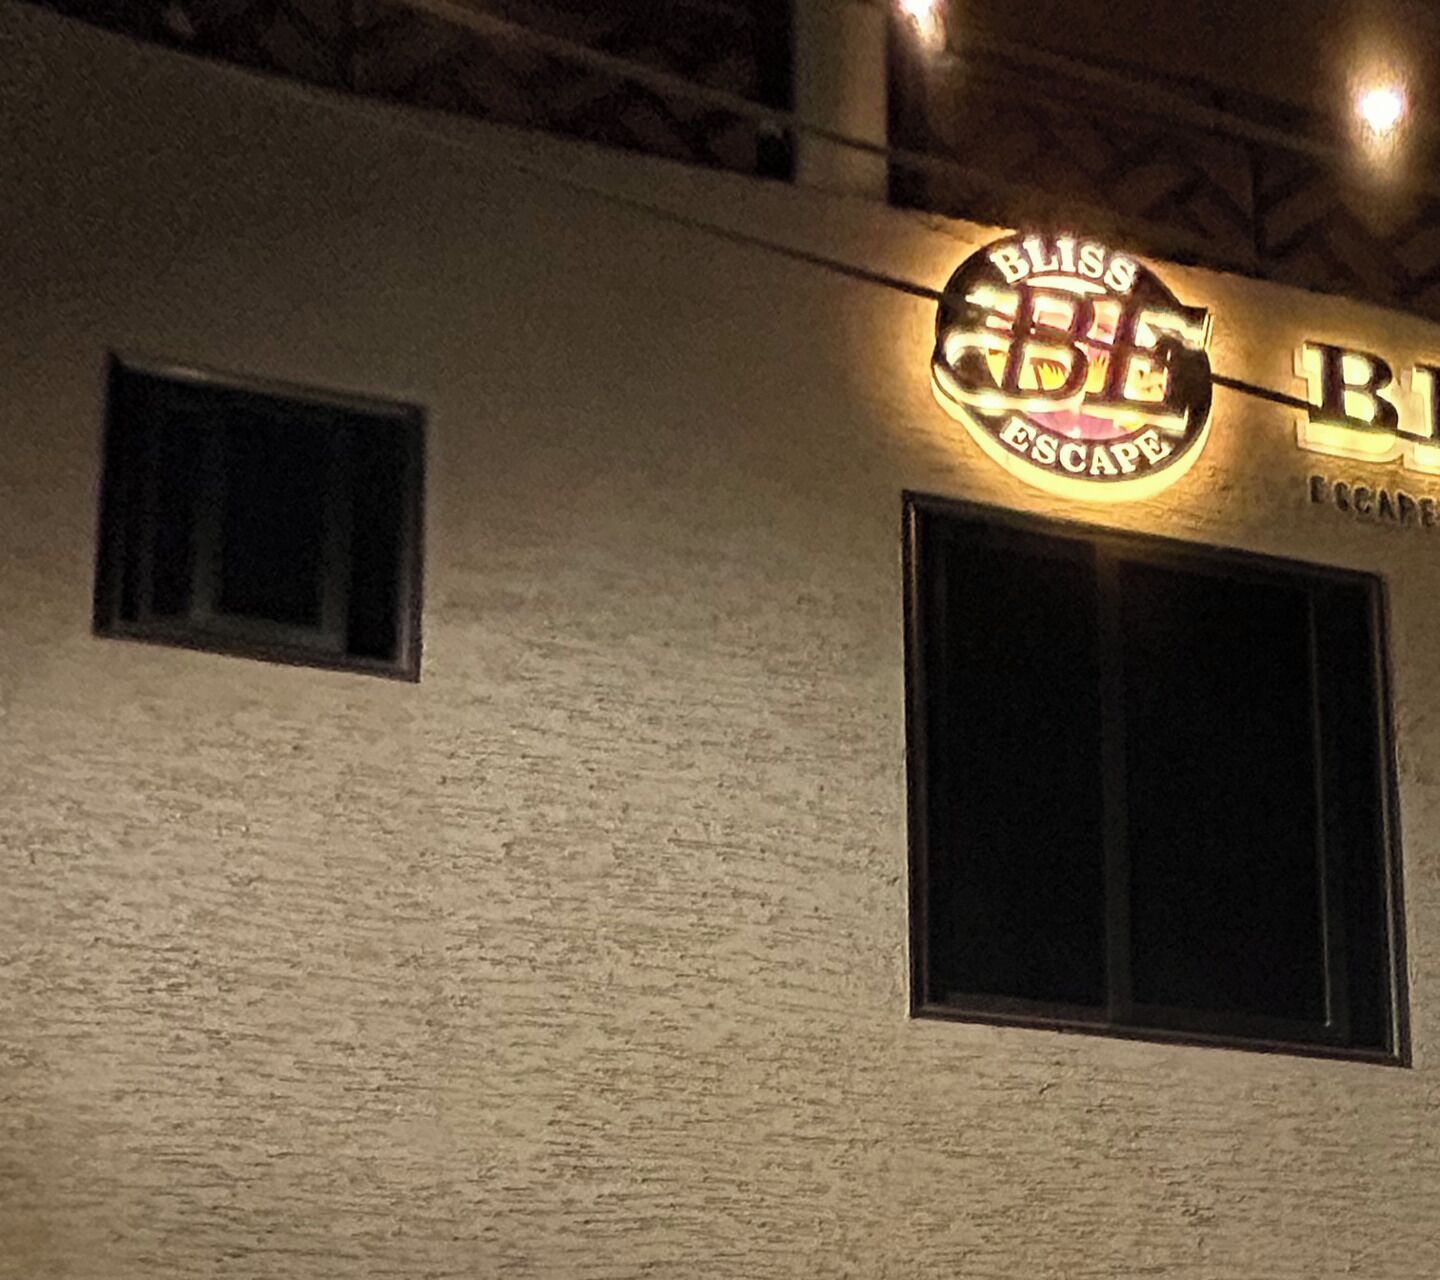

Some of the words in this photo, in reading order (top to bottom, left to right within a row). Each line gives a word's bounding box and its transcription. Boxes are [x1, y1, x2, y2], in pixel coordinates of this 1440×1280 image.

[990, 236, 1136, 293] BLISS
[1000, 416, 1172, 476] ESCAPE
[1307, 474, 1438, 528] ESCAPE
